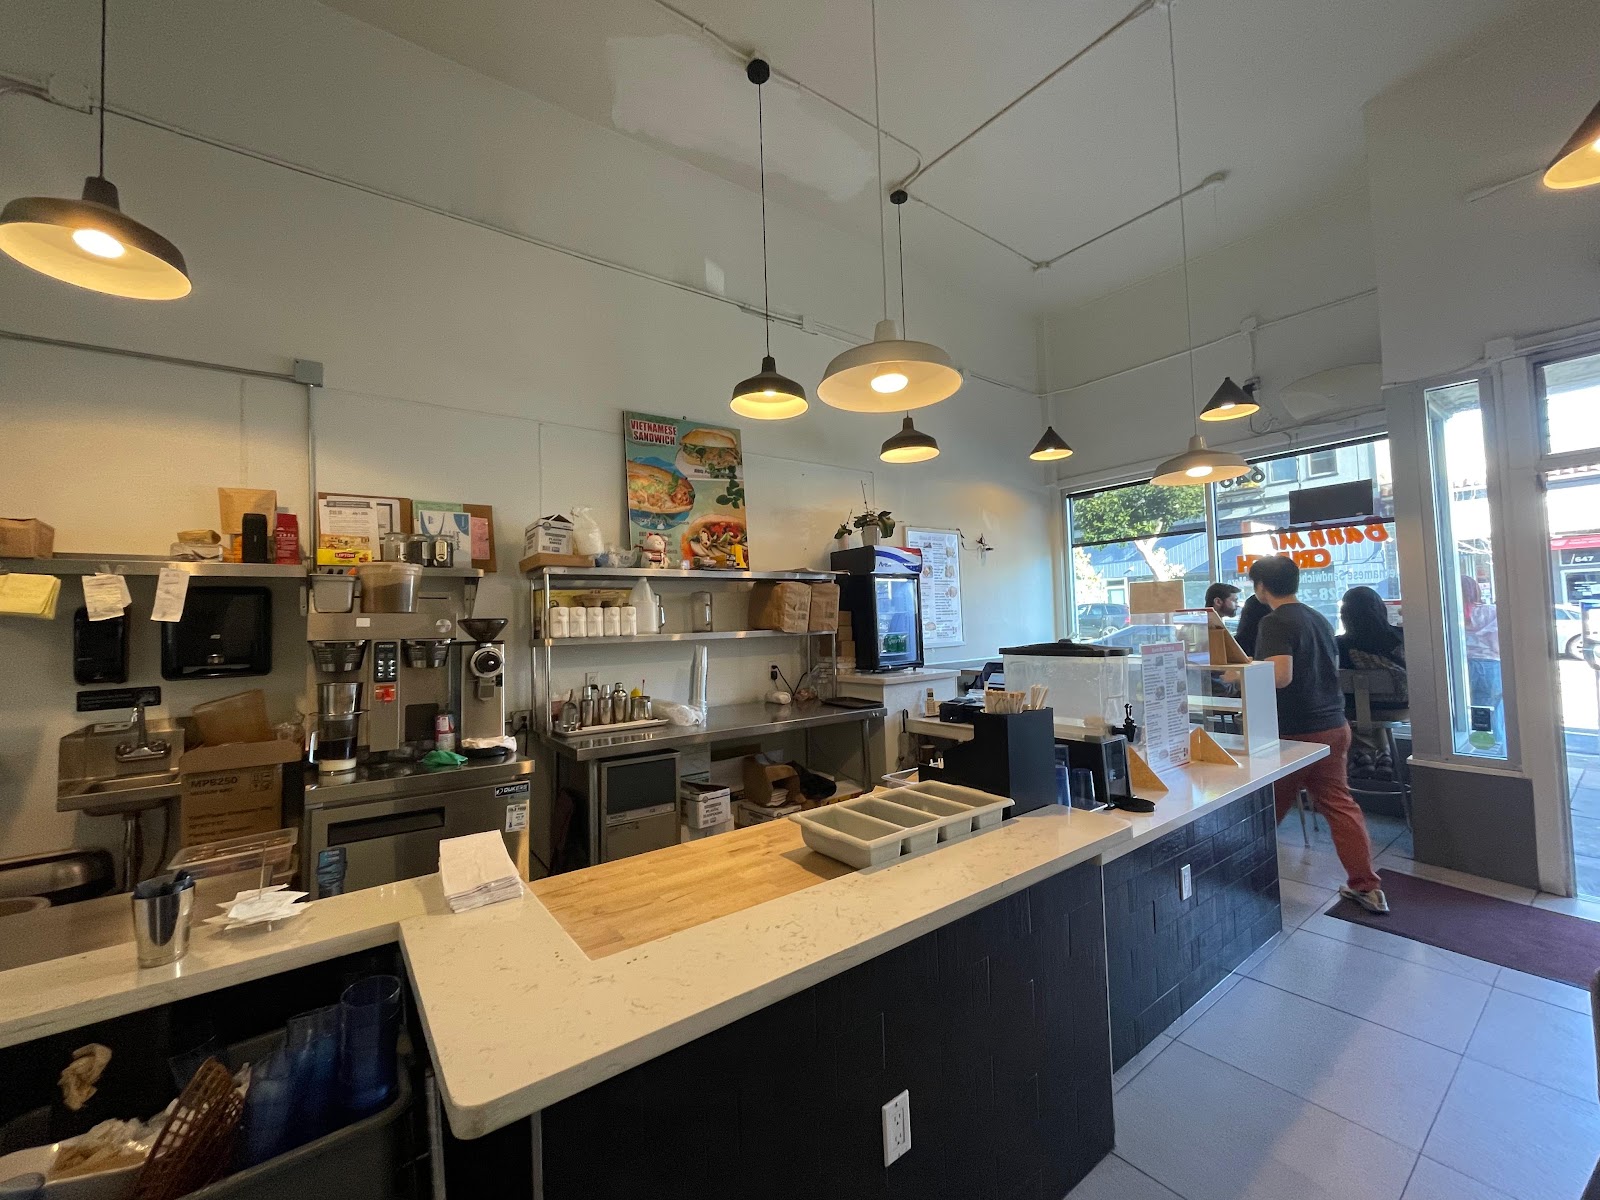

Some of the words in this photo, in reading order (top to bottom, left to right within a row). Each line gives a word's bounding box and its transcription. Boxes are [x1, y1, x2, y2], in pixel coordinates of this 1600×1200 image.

[630, 419, 677, 436] VIETNAMESE
[633, 430, 676, 446] SANDWICH
[503, 784, 528, 793] DUKERS
